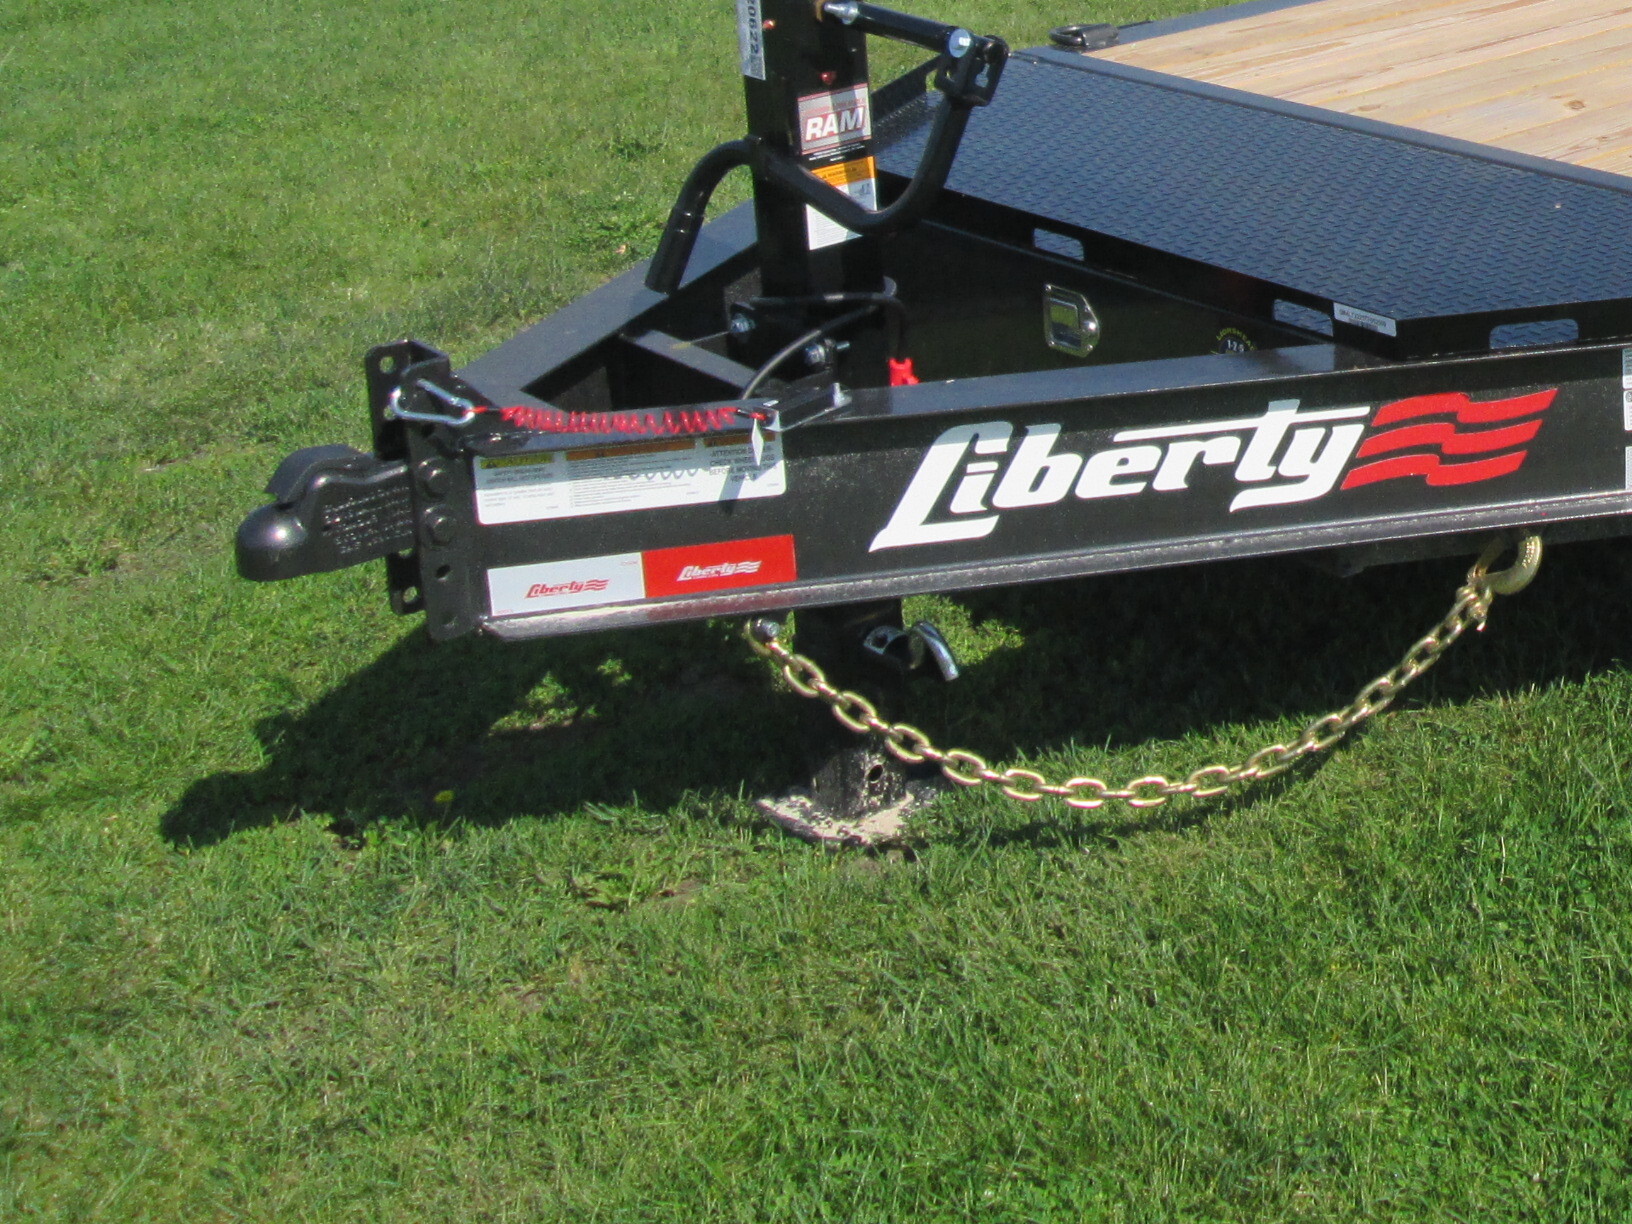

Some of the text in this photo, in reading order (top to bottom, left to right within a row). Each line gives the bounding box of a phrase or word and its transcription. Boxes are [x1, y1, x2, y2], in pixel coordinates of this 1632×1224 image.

[804, 105, 865, 142] RAM
[867, 398, 1371, 554] Liberty
[676, 561, 739, 582] Liberty
[524, 580, 585, 599] Liberty
